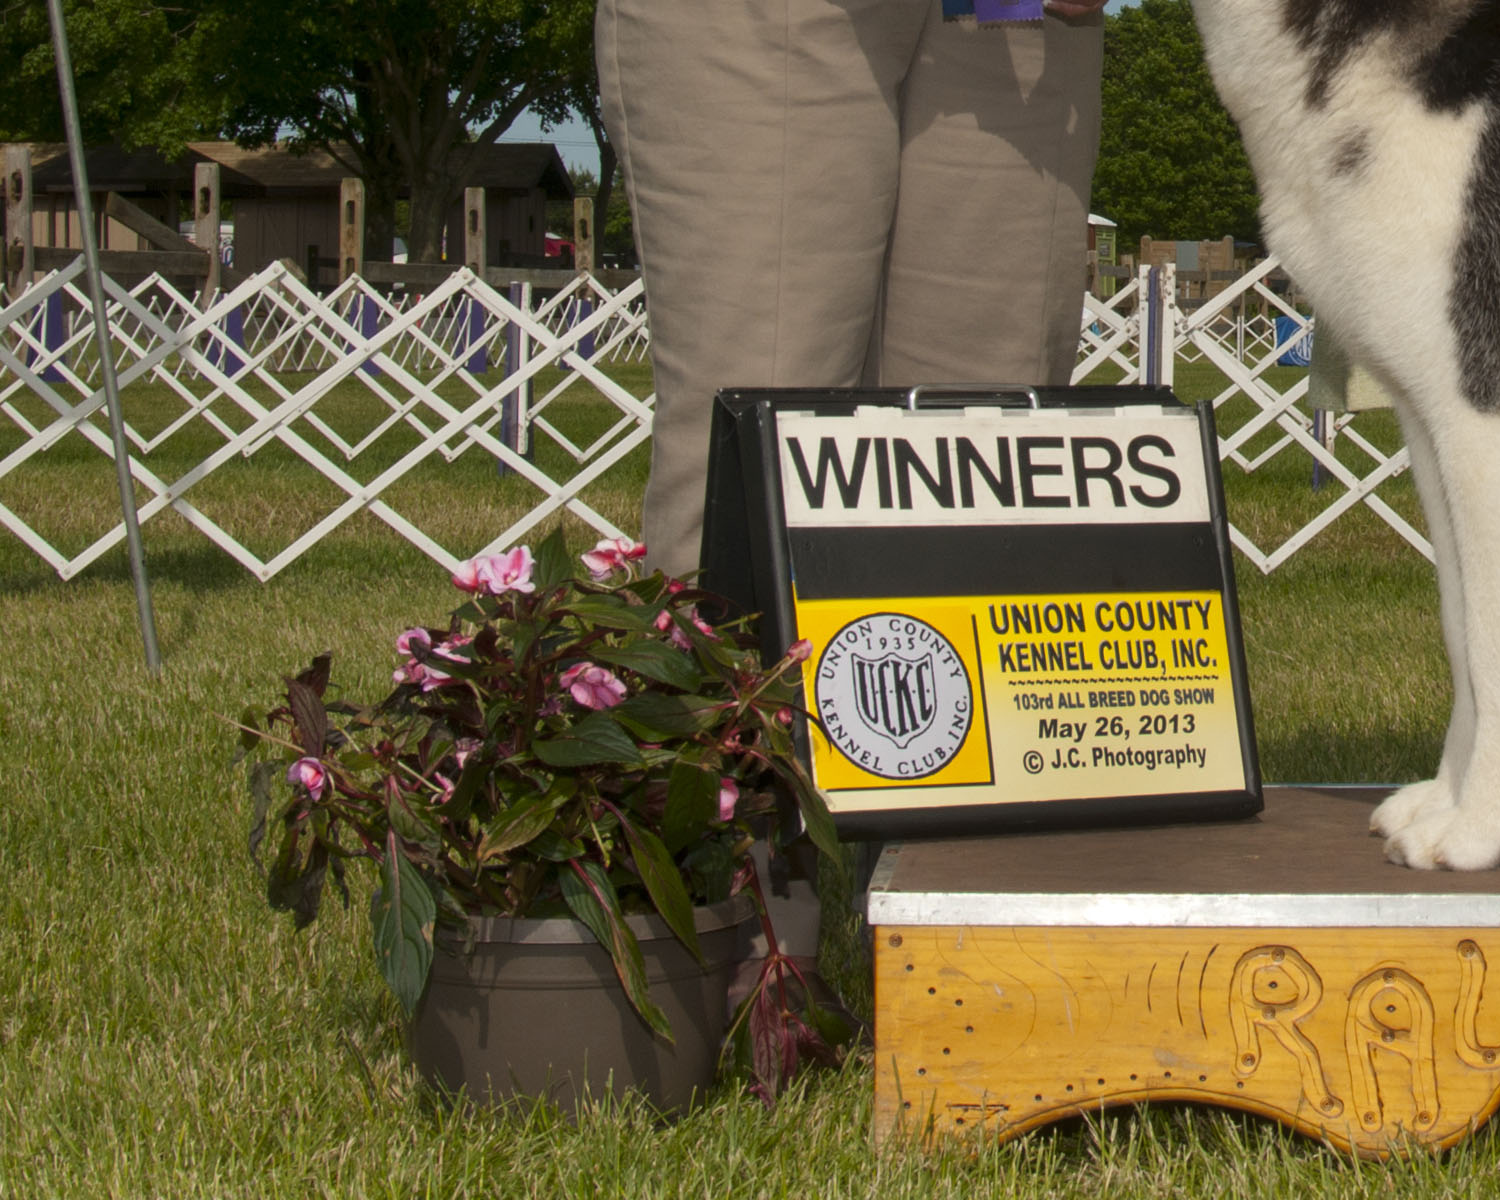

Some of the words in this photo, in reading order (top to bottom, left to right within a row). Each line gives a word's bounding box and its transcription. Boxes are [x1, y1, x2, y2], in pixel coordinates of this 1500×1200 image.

[784, 434, 1182, 510] WINNERS
[988, 602, 1087, 635] UNION
[1094, 599, 1212, 632] COUNTY
[821, 621, 873, 681] UNION
[888, 618, 963, 679] COUNTY
[866, 637, 916, 651] 1935
[998, 641, 1093, 673] KENNEL
[1098, 639, 1167, 675] CLUB,
[1171, 638, 1218, 668] INC.
[1013, 693, 1054, 710] 103rd
[1058, 691, 1086, 709] ALL
[1088, 690, 1136, 708] BREED
[1140, 688, 1170, 706] DOG
[1174, 688, 1215, 705] SHOW
[821, 697, 884, 772] KENNEL
[1038, 718, 1087, 743] May
[1095, 715, 1130, 740] 26,
[1138, 713, 1196, 735] 2013
[1051, 748, 1086, 769] J.C.
[1091, 743, 1207, 770] Photography
